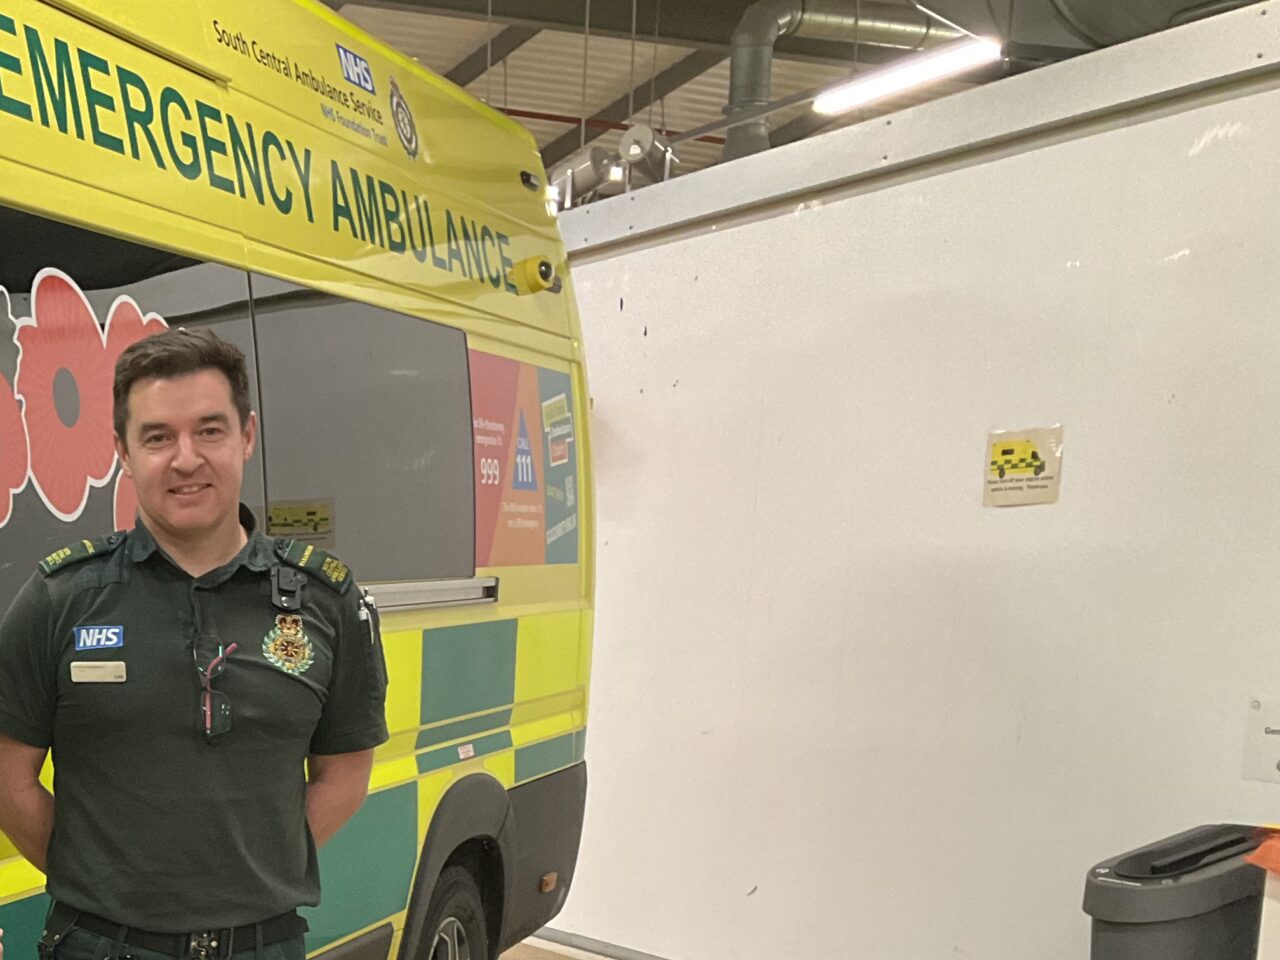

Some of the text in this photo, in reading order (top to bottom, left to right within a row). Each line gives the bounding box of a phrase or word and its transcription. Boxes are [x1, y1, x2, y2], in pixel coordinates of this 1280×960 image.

[213, 20, 384, 125] South Central Ambulance Service
[338, 46, 374, 92] NHS
[331, 159, 518, 296] AMBULANCE
[480, 454, 532, 485] 999 111
[79, 628, 120, 647] NHS
